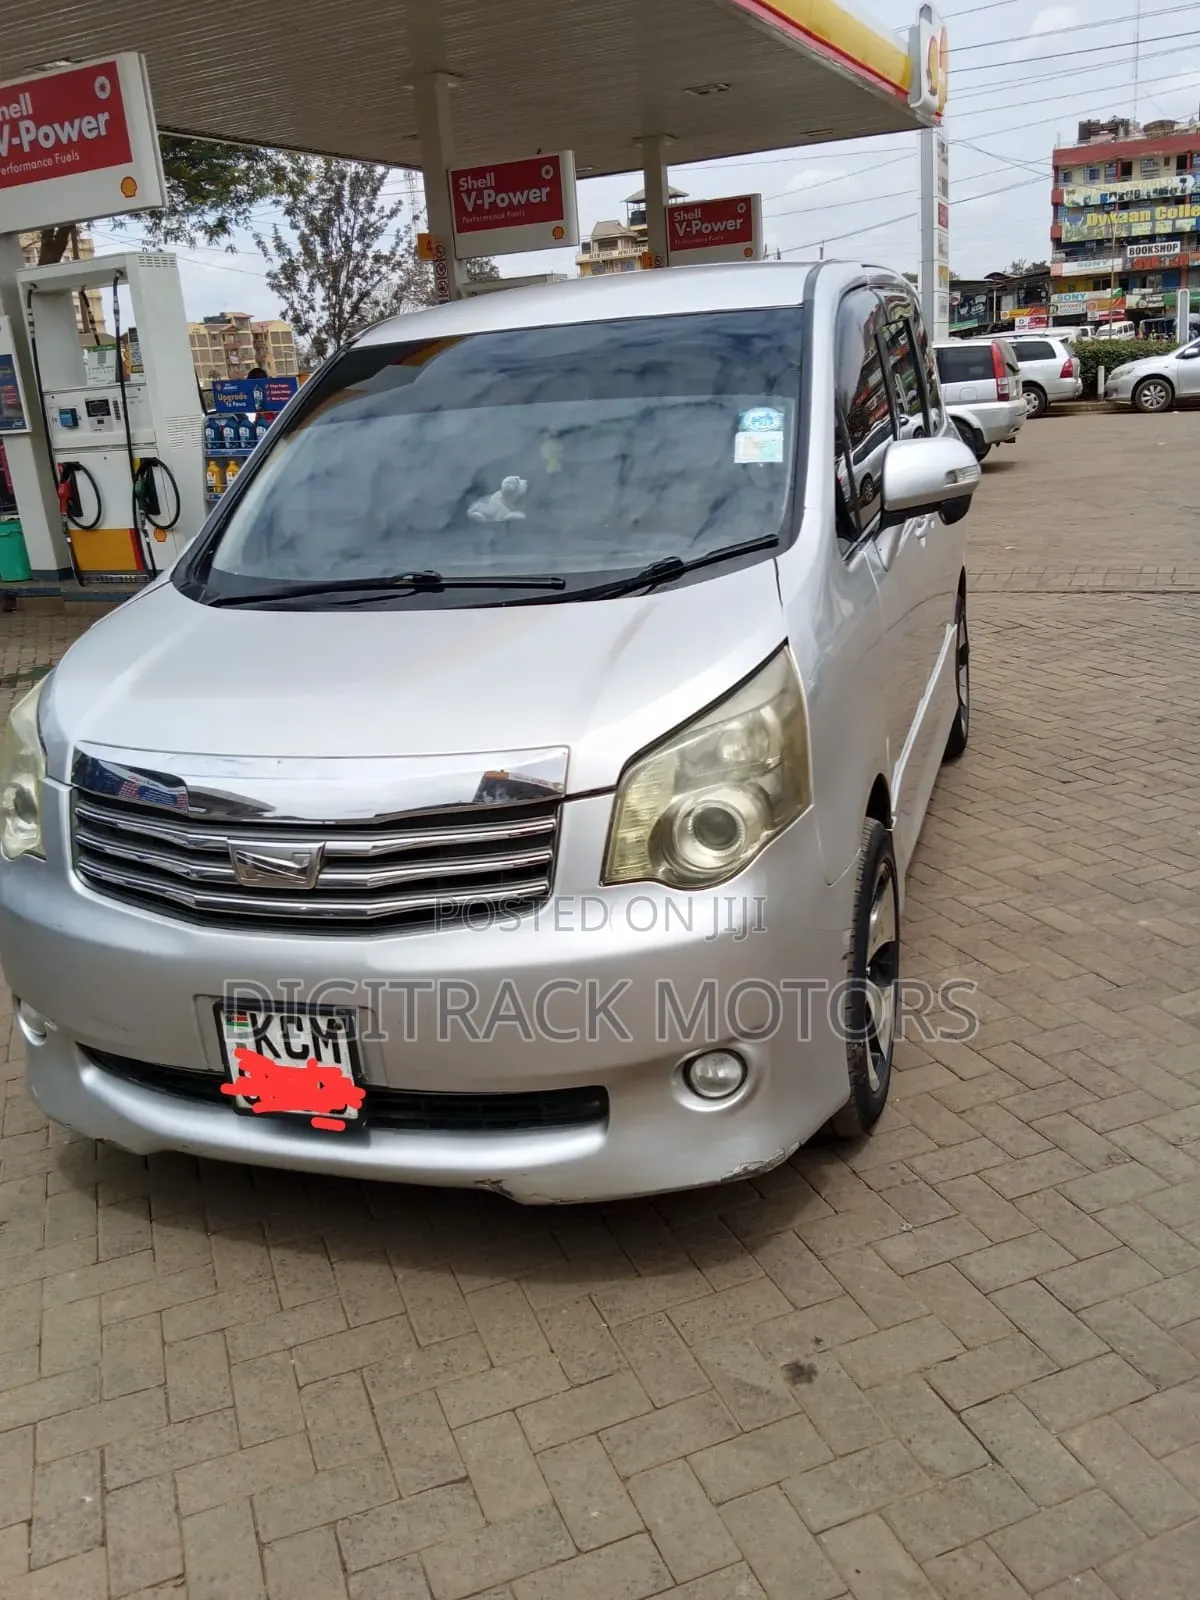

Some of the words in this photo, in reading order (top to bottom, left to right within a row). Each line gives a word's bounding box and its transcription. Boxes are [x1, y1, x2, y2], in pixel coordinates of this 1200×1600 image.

[0, 112, 110, 157] V-Power
[0, 158, 53, 176] erformance
[55, 150, 80, 163] Fuels
[459, 172, 495, 191] Shell
[461, 187, 550, 212] V-Power
[673, 208, 701, 222] Shell
[675, 218, 744, 237] V-Power
[1129, 243, 1179, 256] BOOKSHOP
[1077, 260, 1107, 268] SONY
[1056, 293, 1087, 301] SONY
[250, 1012, 346, 1064] KCM
